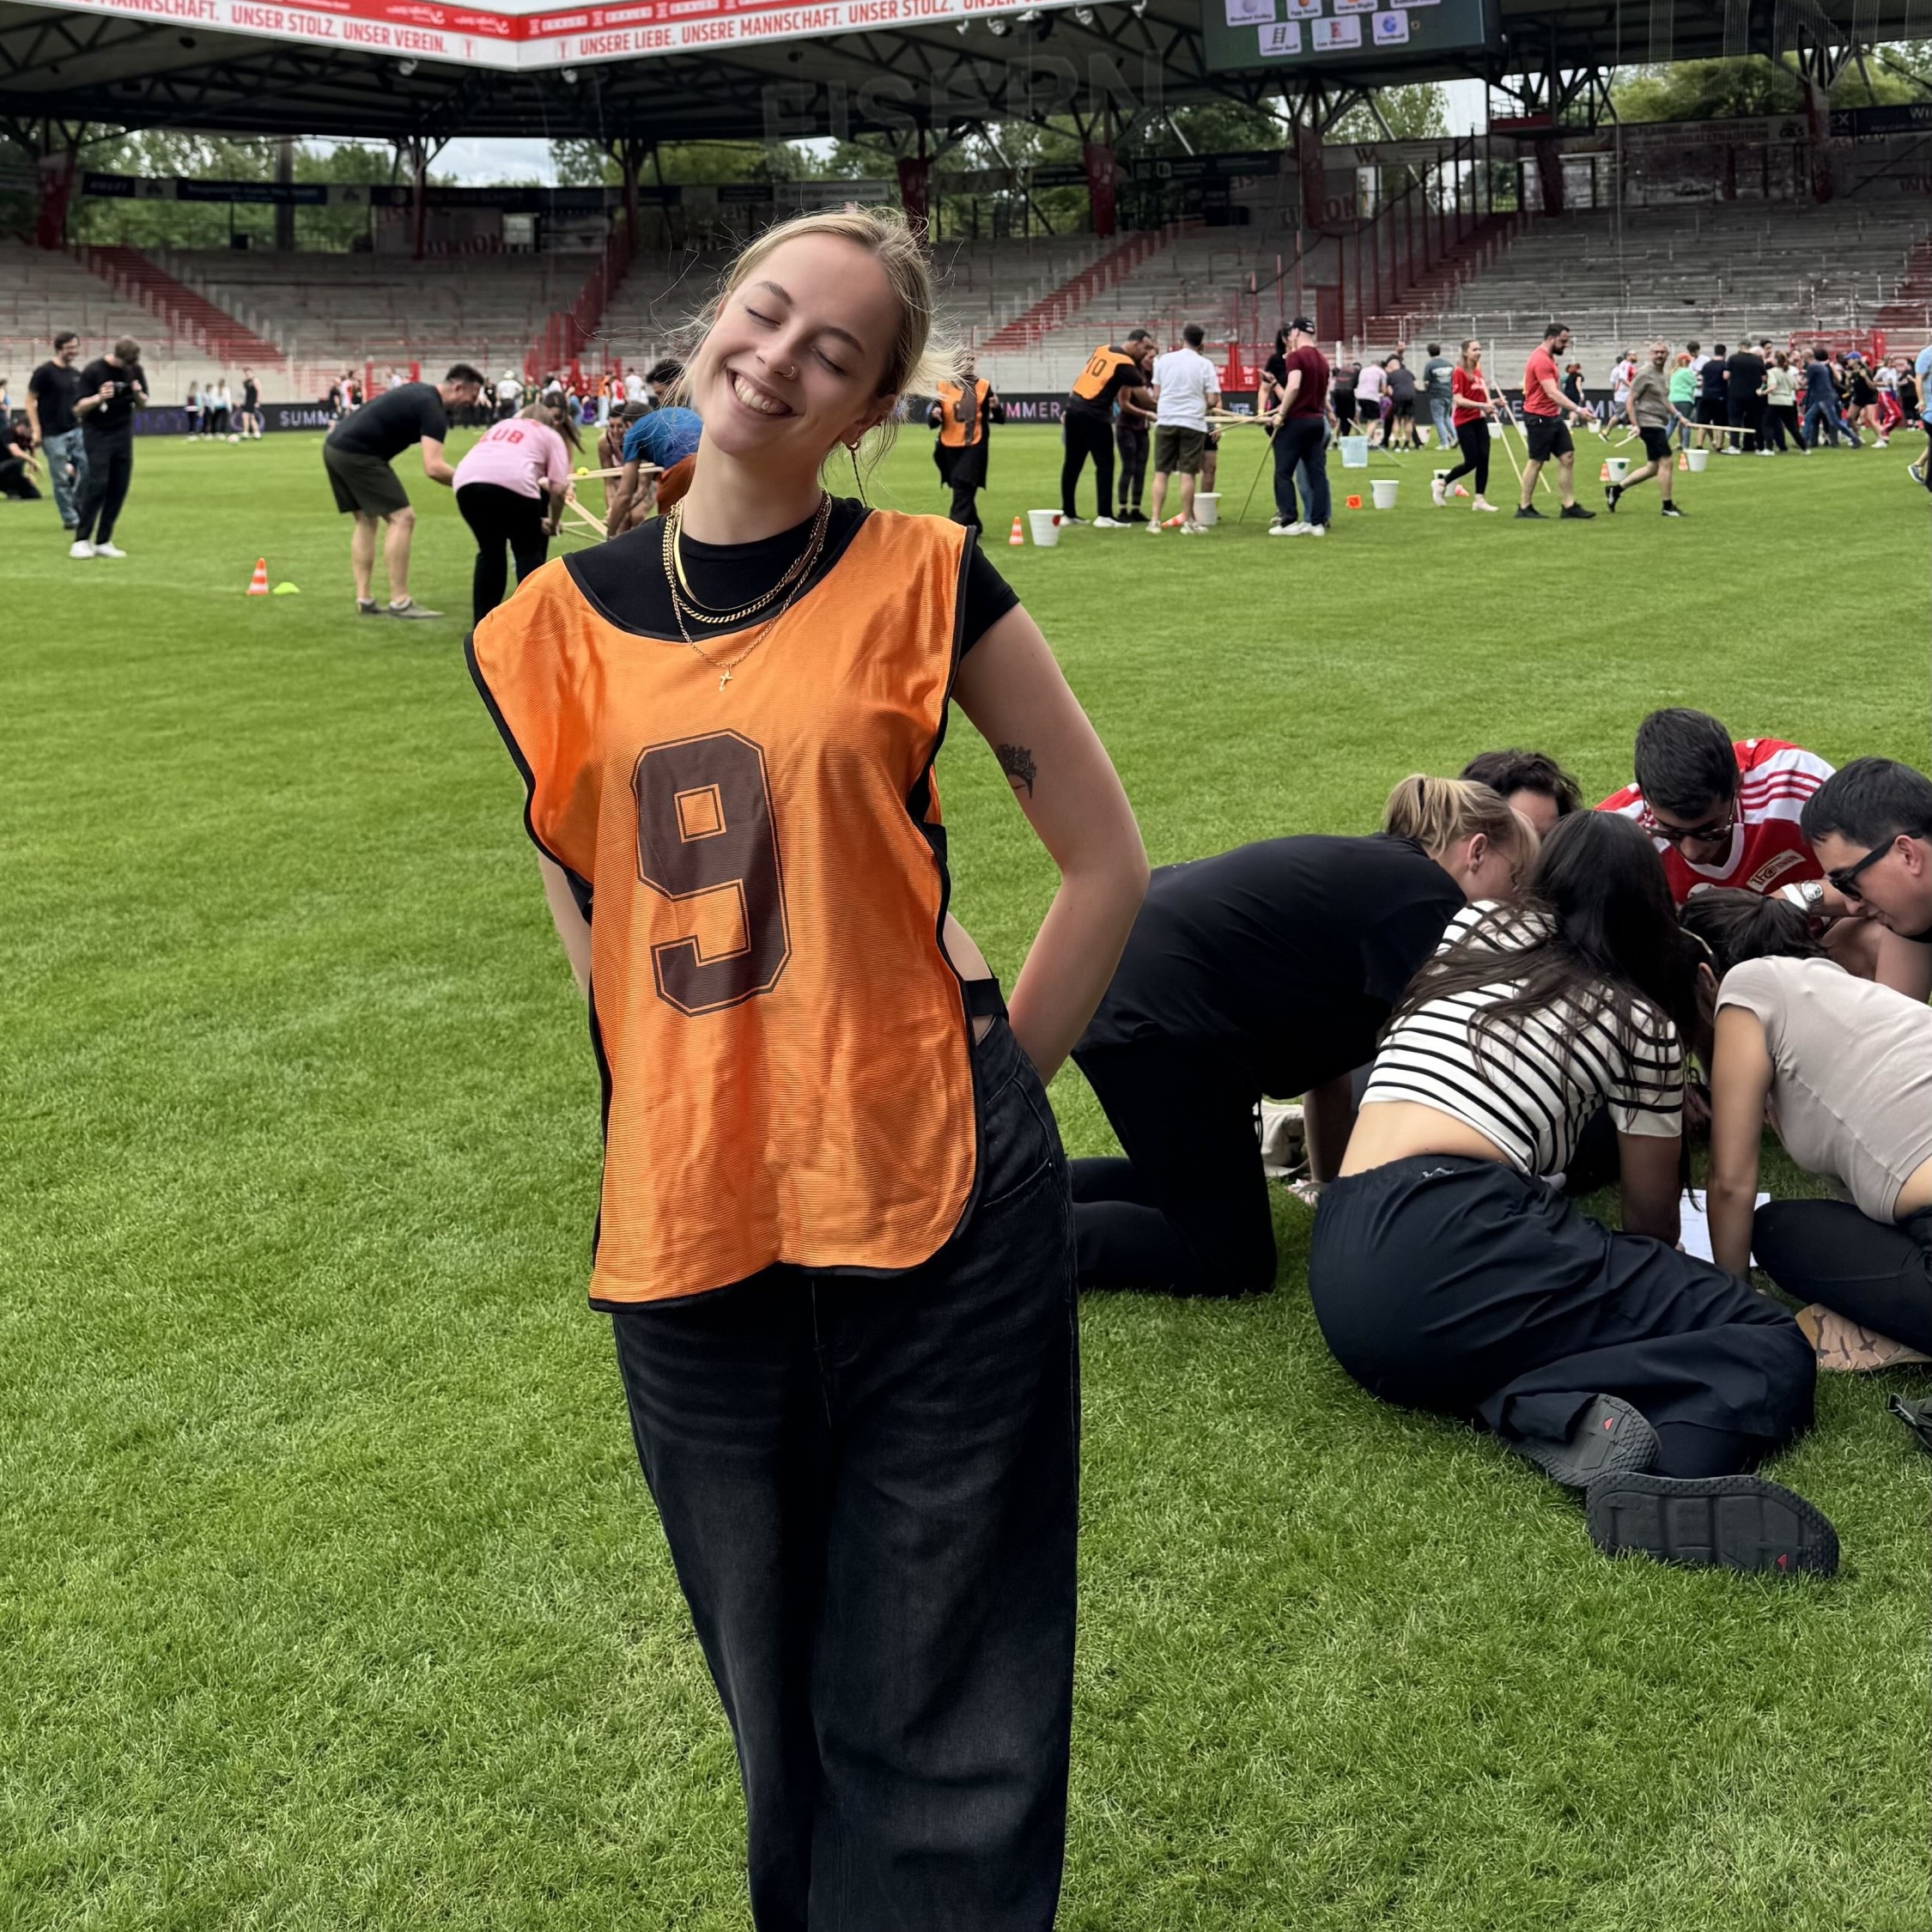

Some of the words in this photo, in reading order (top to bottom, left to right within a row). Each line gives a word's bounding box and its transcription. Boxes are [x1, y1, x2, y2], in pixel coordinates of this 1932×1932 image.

[231, 5, 283, 29] UNSER
[288, 13, 337, 38] STOLZ.
[343, 21, 391, 46] UNSER
[394, 29, 447, 52] VEREIN.
[580, 33, 630, 56] UNSERE
[635, 28, 677, 49] LIEBE.
[682, 21, 734, 44] UNSERE
[739, 7, 842, 37] MANNSCHAFT.
[848, 1, 898, 23] UNSER
[1085, 355, 1107, 377] 10
[279, 410, 330, 427] SUMM
[1002, 401, 1060, 419] MMER
[630, 728, 792, 1018] 9
